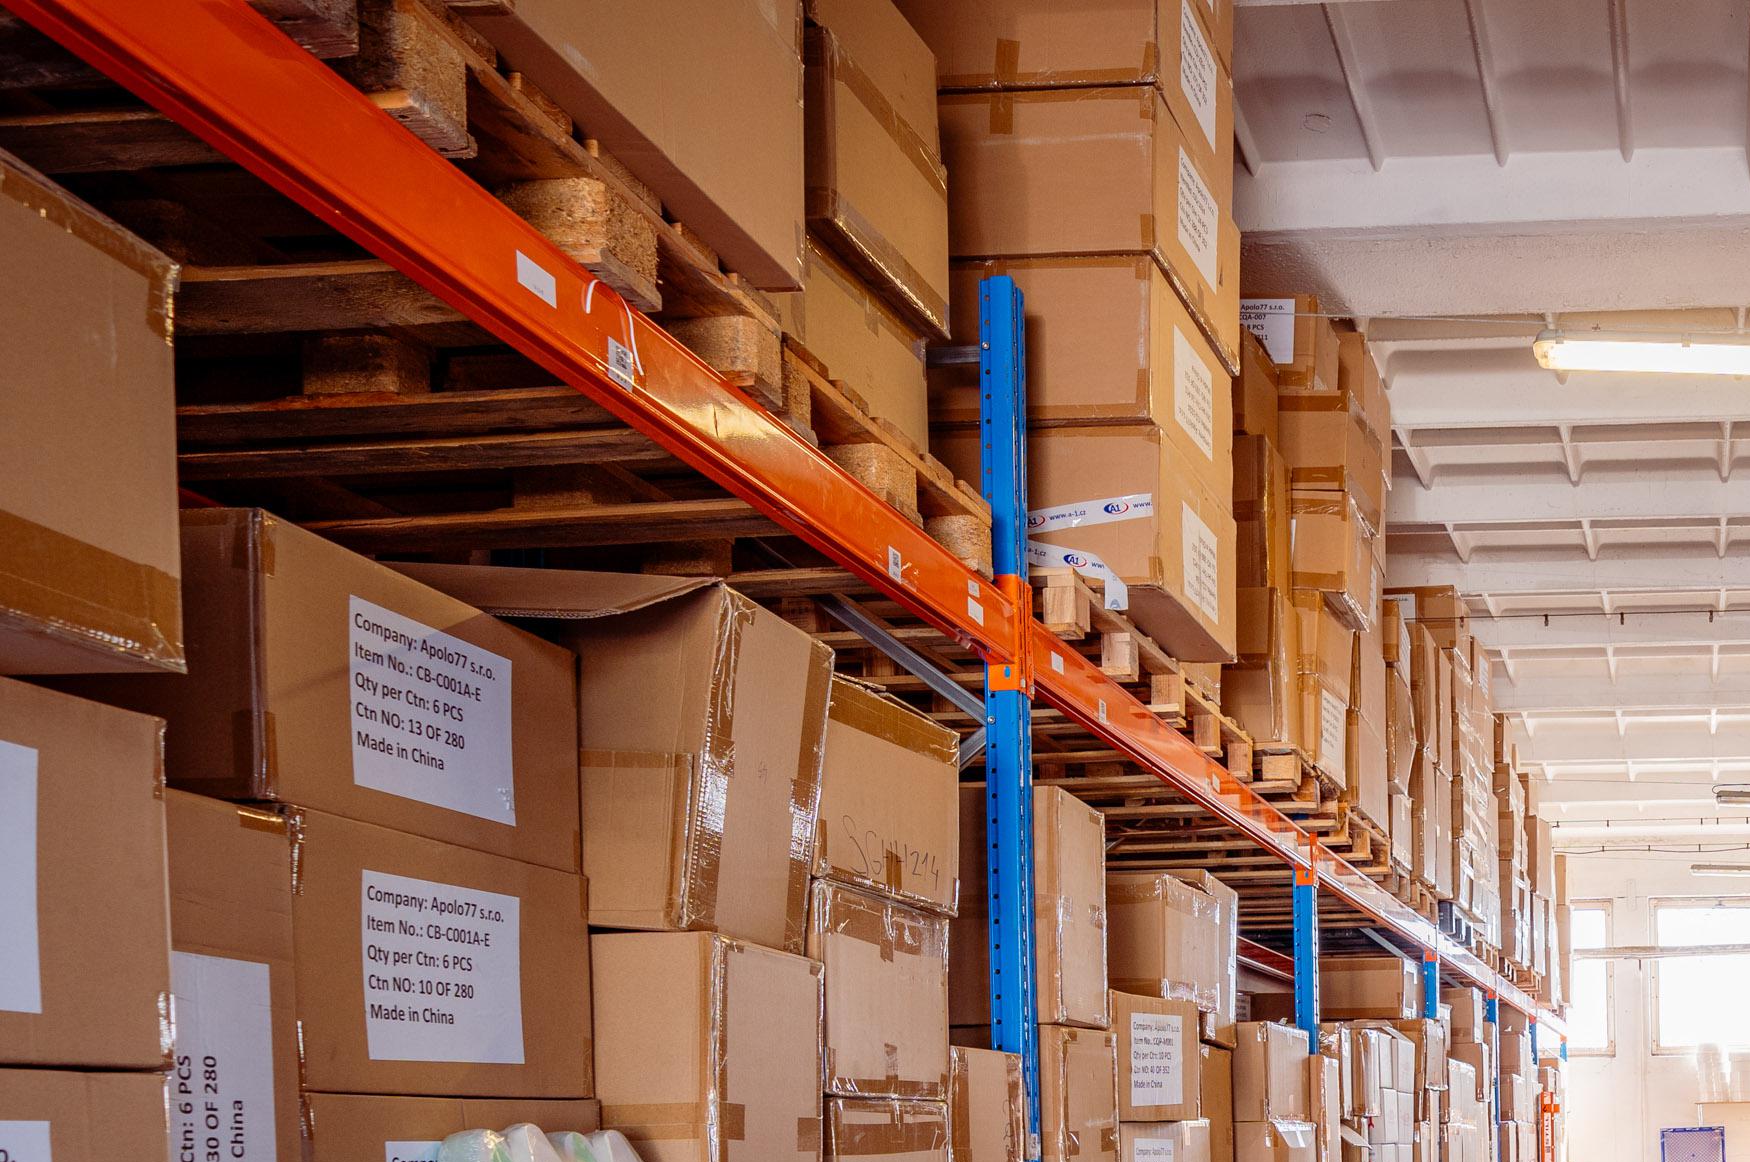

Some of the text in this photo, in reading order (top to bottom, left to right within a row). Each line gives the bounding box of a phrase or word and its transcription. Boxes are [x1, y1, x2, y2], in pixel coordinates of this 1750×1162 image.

[1048, 511, 1087, 521] www.a-1.cz
[354, 612, 495, 680] Company: Apolo77 s.r.o.
[354, 641, 481, 702] Item No.: CB-C001A-E
[354, 671, 463, 722] Qty per Ctn: 6 PCS
[355, 701, 464, 749] Ctn NO: 13 OF 280
[356, 730, 444, 770] Made in China
[366, 884, 504, 922] Company: Apolo77 s.r.o.
[366, 914, 490, 947] Item No.: CB-C001A-E
[366, 944, 472, 971] Qty per Ctn: 6 PCS
[368, 973, 473, 999] Ctn NO: 10 OF 280
[369, 1003, 454, 1024] Made in China
[176, 1055, 192, 1094] PCS
[202, 1055, 217, 1094] 280
[178, 1101, 193, 1114] 6
[204, 1101, 219, 1130] OF
[230, 1099, 244, 1158] China
[205, 1136, 219, 1162] 30
